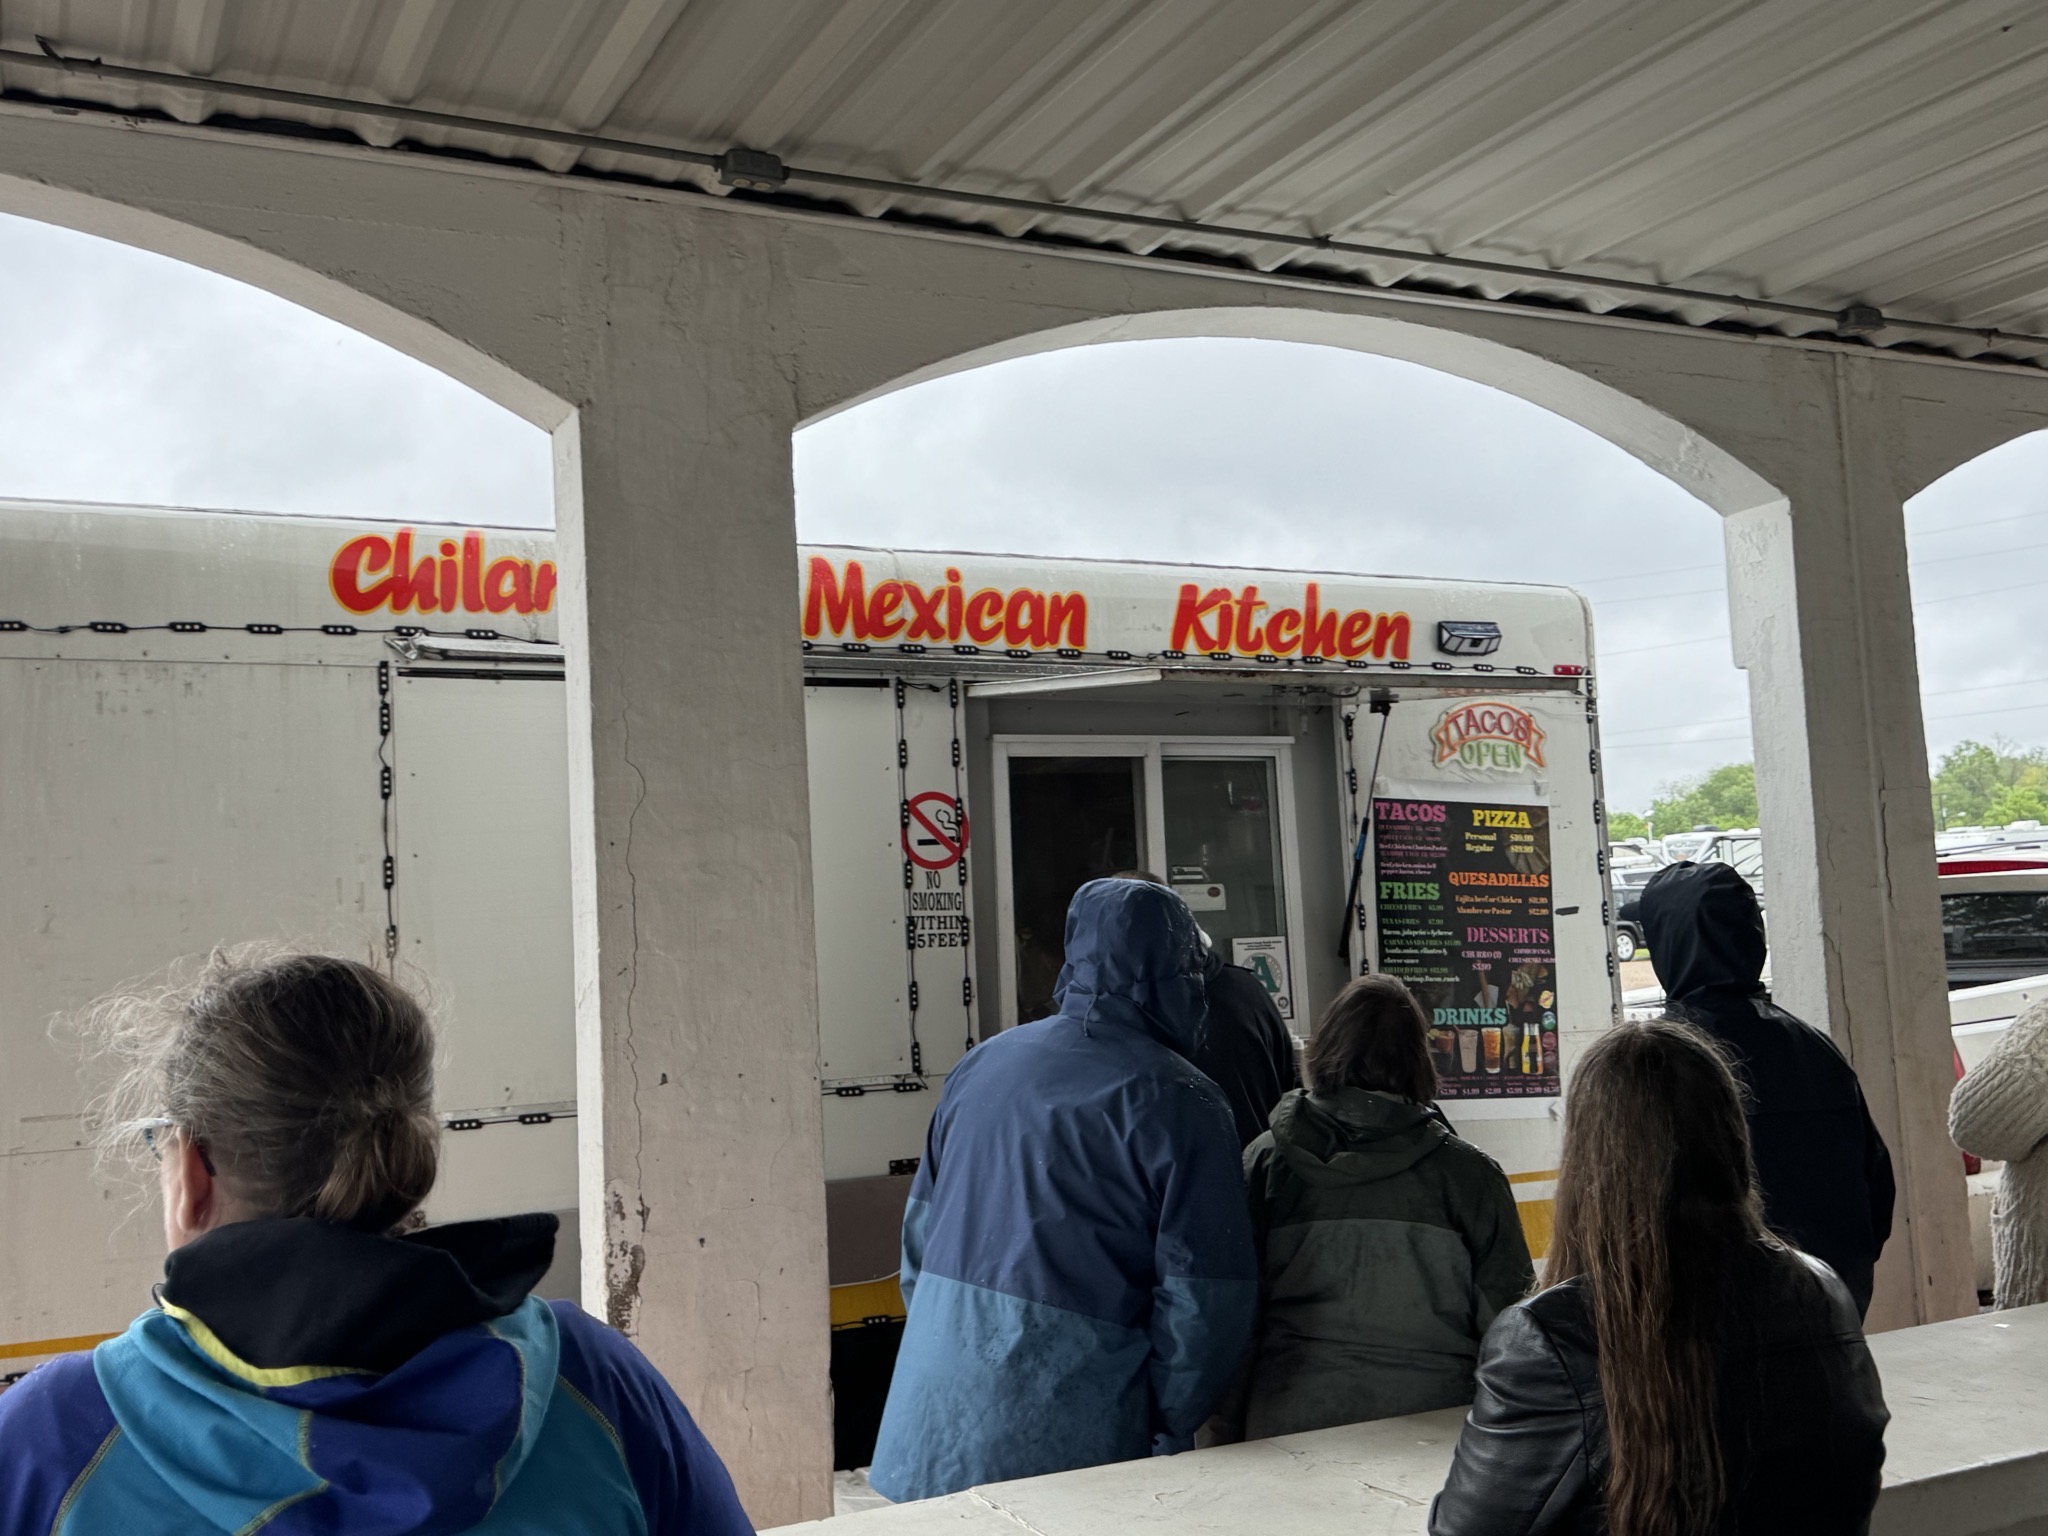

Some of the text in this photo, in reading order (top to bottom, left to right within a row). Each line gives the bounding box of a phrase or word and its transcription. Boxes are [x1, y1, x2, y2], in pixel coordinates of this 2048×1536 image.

[801, 555, 1087, 649] Mexican
[1169, 581, 1410, 660] Kitchen
[1448, 709, 1529, 741] TACOS
[1461, 741, 1521, 768] OPEN
[1375, 801, 1446, 823] TACOS
[1472, 809, 1532, 829] PIZZA
[1464, 831, 1497, 841] Personal
[1465, 843, 1495, 853] Regular
[925, 870, 941, 889] NO
[1448, 872, 1549, 888] QUESADILLAS
[1380, 881, 1440, 900] FRIES
[1497, 896, 1522, 904] Chicken
[912, 892, 962, 911] SMOKING
[1492, 907, 1512, 915] Pastor
[1466, 927, 1550, 944] DESSERTS
[1433, 1008, 1507, 1025] DRINKS
